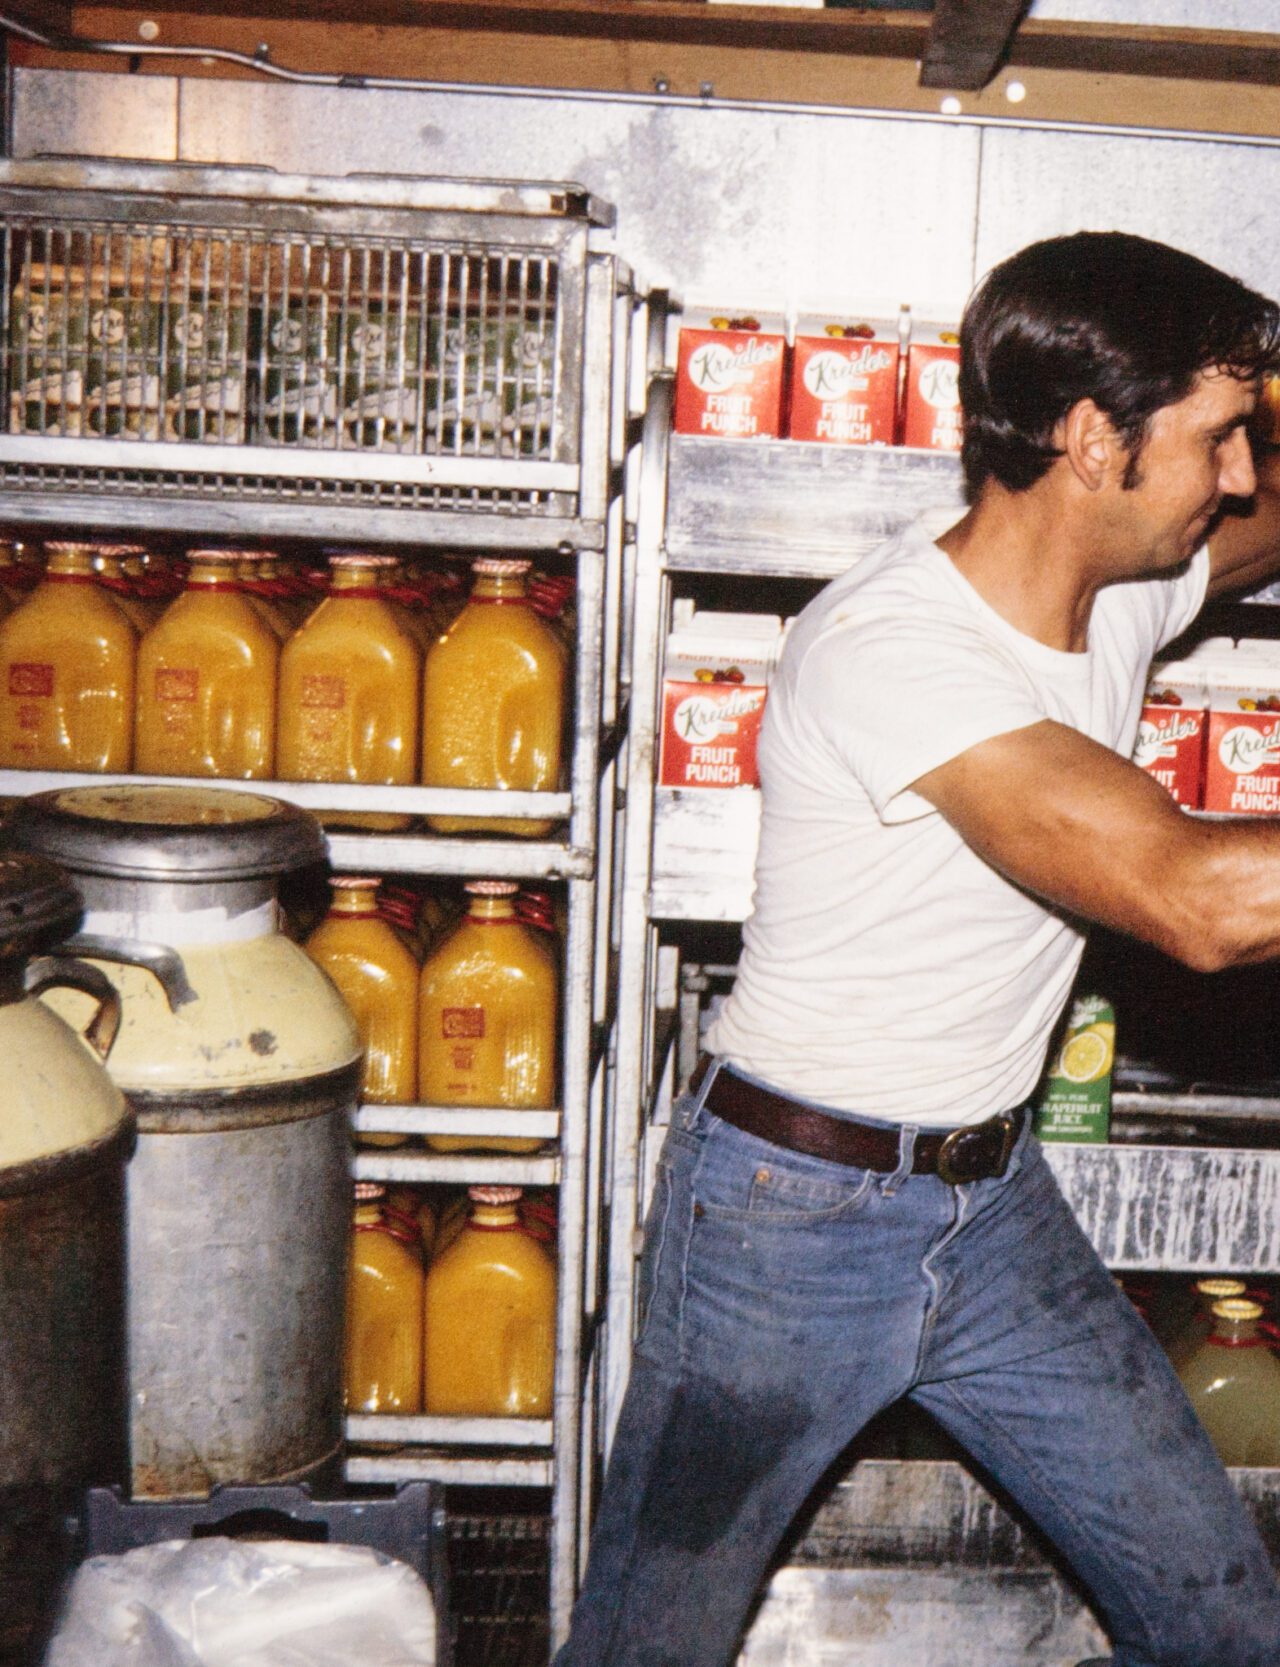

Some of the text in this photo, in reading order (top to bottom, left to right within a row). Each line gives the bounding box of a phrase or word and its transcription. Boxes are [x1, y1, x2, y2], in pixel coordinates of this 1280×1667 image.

[694, 337, 775, 385] Kreider
[809, 345, 891, 393] Kreider
[706, 395, 752, 413] FRUIT
[822, 401, 868, 421] FRUIT
[701, 411, 757, 433] PUNCH
[817, 420, 871, 440] PUNCH
[678, 689, 758, 738] Kreider
[1135, 713, 1199, 757] reider
[691, 746, 737, 764] FRUIT
[685, 763, 740, 784] PUNCH
[1236, 775, 1280, 793] FRUIT
